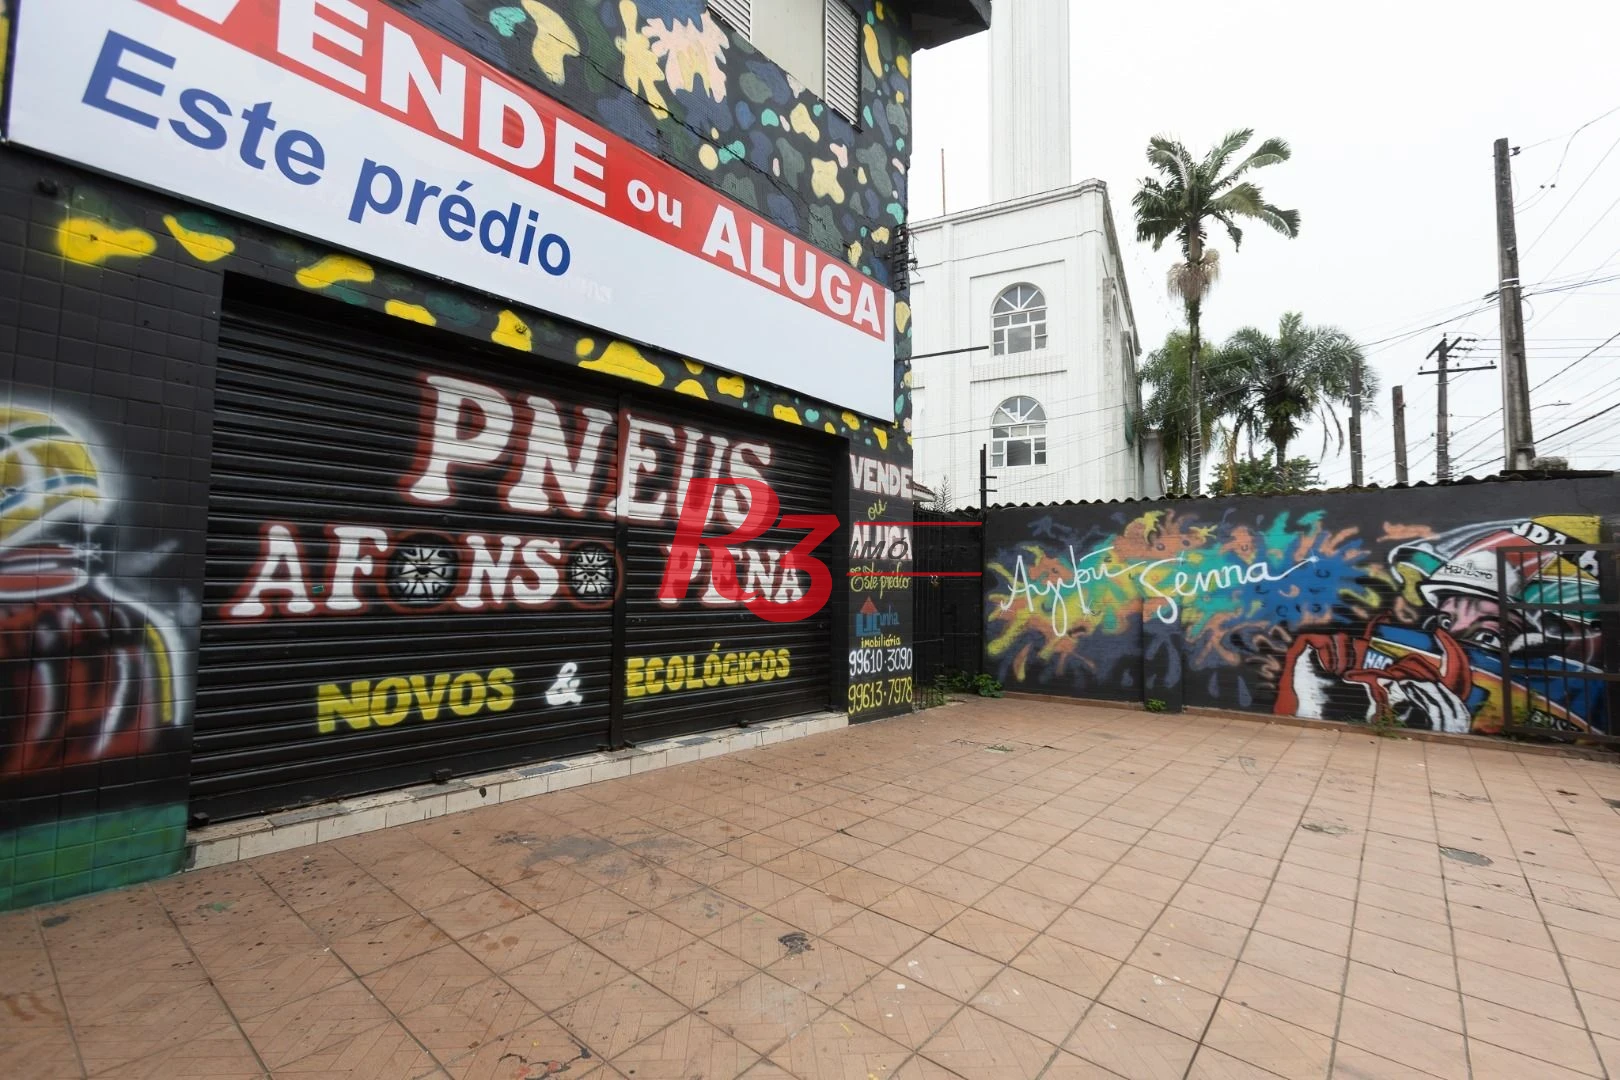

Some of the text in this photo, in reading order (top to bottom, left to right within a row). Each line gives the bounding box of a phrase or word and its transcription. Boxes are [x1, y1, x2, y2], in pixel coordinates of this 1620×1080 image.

[82, 29, 572, 276] Este prédio
[176, 0, 882, 335] ENDE ou ALUGA
[405, 374, 773, 532] PNEUS
[849, 453, 913, 498] VENDE
[867, 498, 888, 521] ou
[230, 524, 804, 616] AFONSO PENA
[1140, 556, 1319, 625] Senna
[316, 642, 791, 733] NOVOS & ECOLÓGICOS
